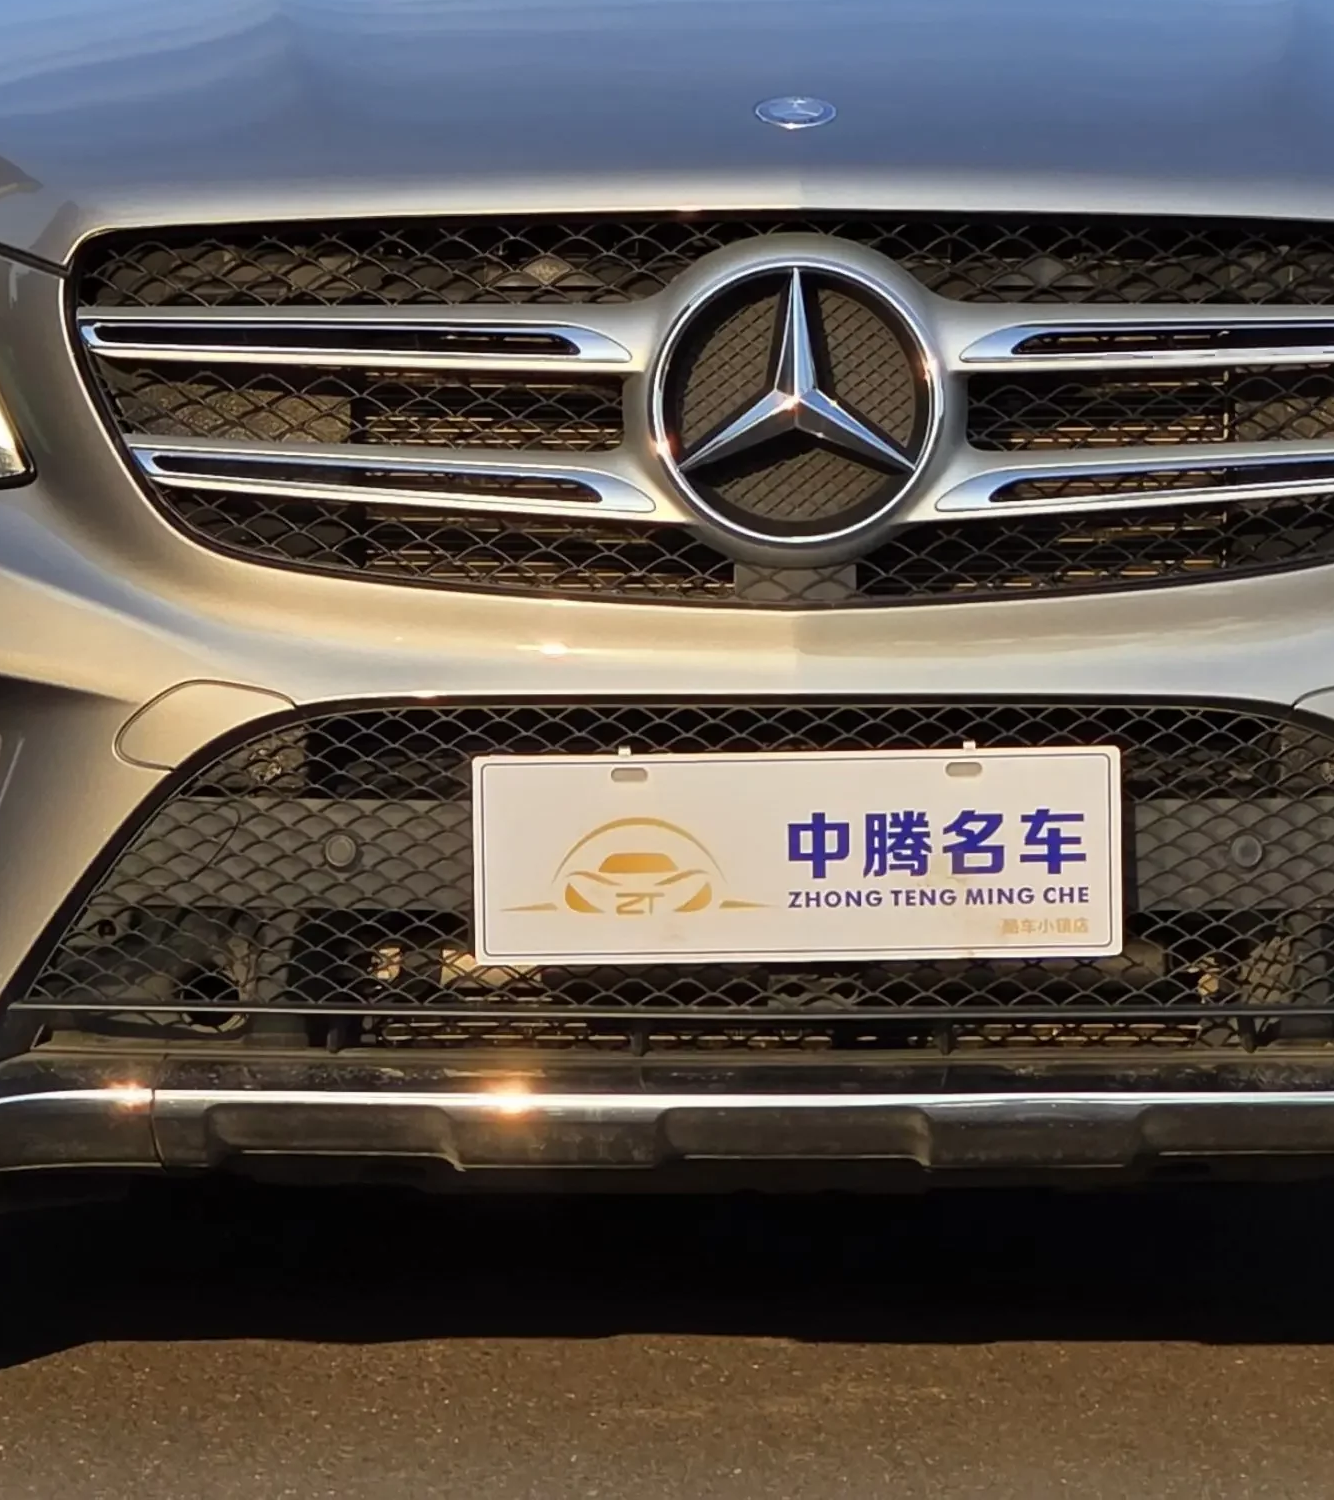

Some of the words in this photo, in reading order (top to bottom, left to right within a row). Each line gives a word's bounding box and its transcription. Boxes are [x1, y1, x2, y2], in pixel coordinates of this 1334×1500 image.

[788, 809, 1087, 879] 中腾名车
[788, 889, 883, 909] ZHONG
[891, 888, 957, 907] TENG
[965, 887, 1035, 906] MING
[1042, 886, 1089, 904] CHE
